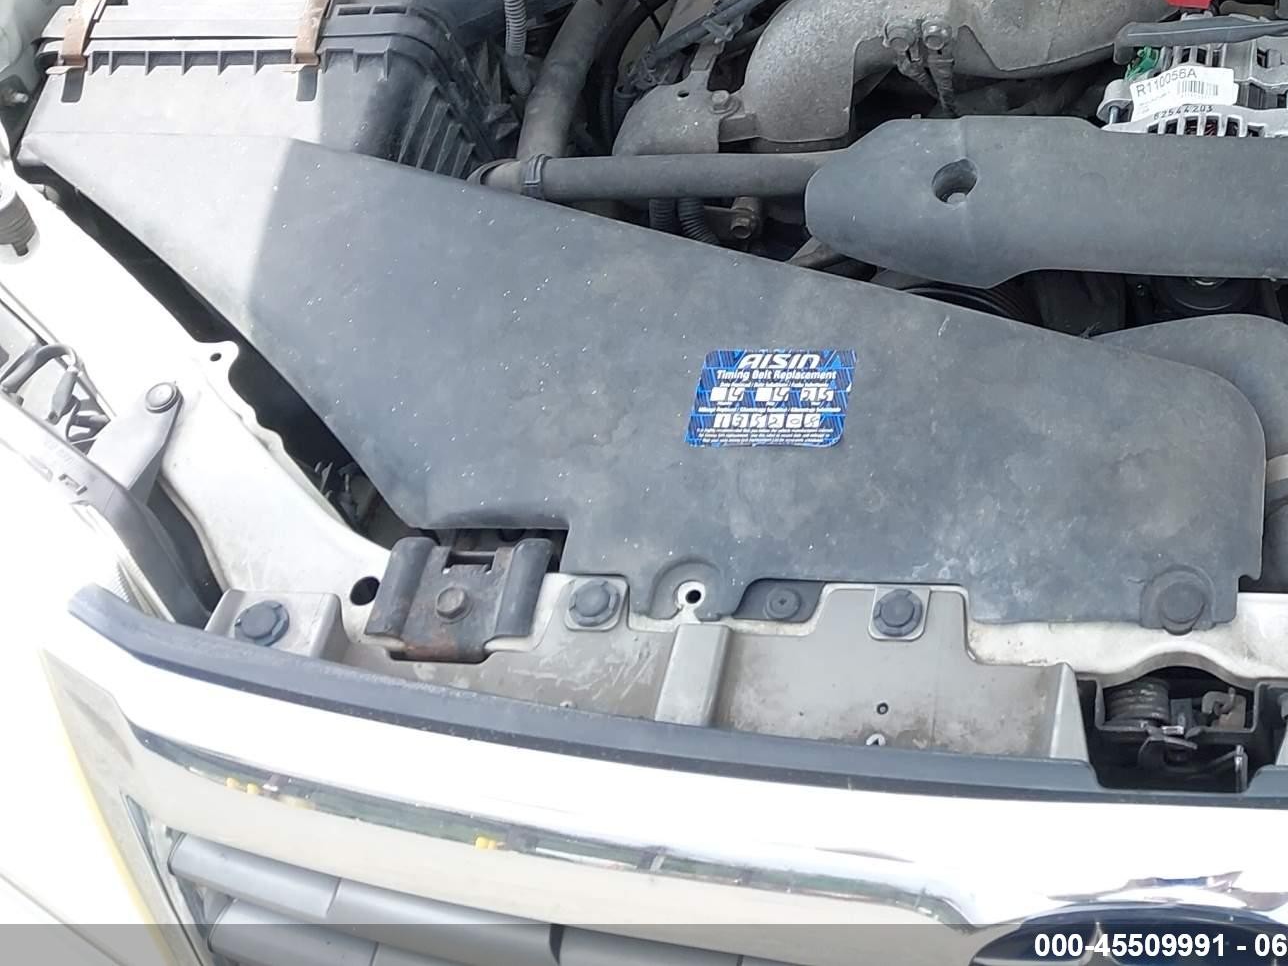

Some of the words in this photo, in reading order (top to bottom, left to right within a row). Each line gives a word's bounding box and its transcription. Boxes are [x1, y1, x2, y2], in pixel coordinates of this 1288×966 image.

[738, 354, 820, 369] AISIN
[717, 370, 750, 381] Timing
[752, 370, 772, 380] Belt
[774, 370, 837, 381] Replacement
